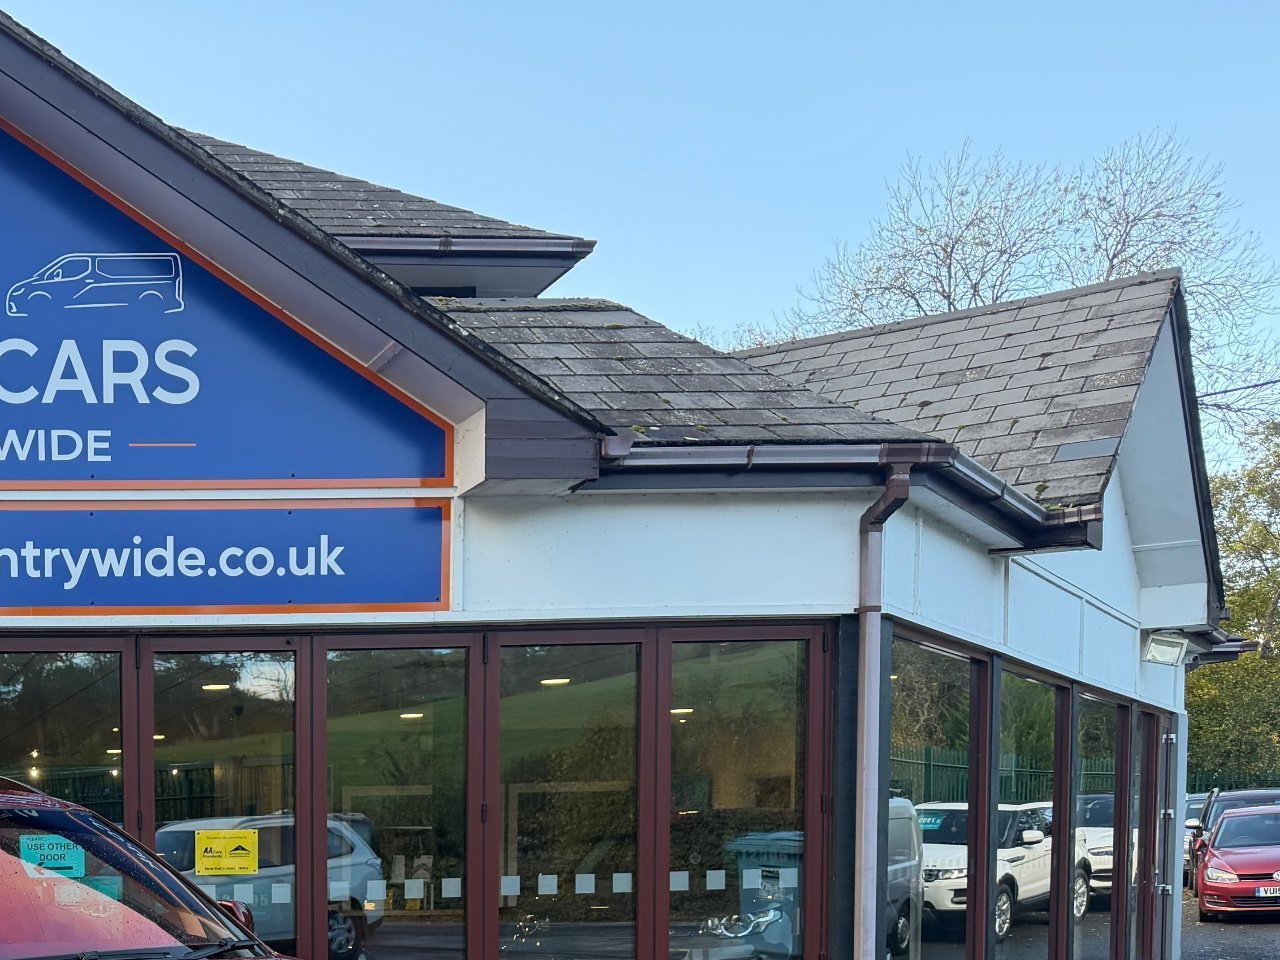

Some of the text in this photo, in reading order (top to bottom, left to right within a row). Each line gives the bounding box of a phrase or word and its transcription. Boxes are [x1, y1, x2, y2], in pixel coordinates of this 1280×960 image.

[27, 843, 79, 851] USE OTHER
[39, 853, 66, 862] DOOR
